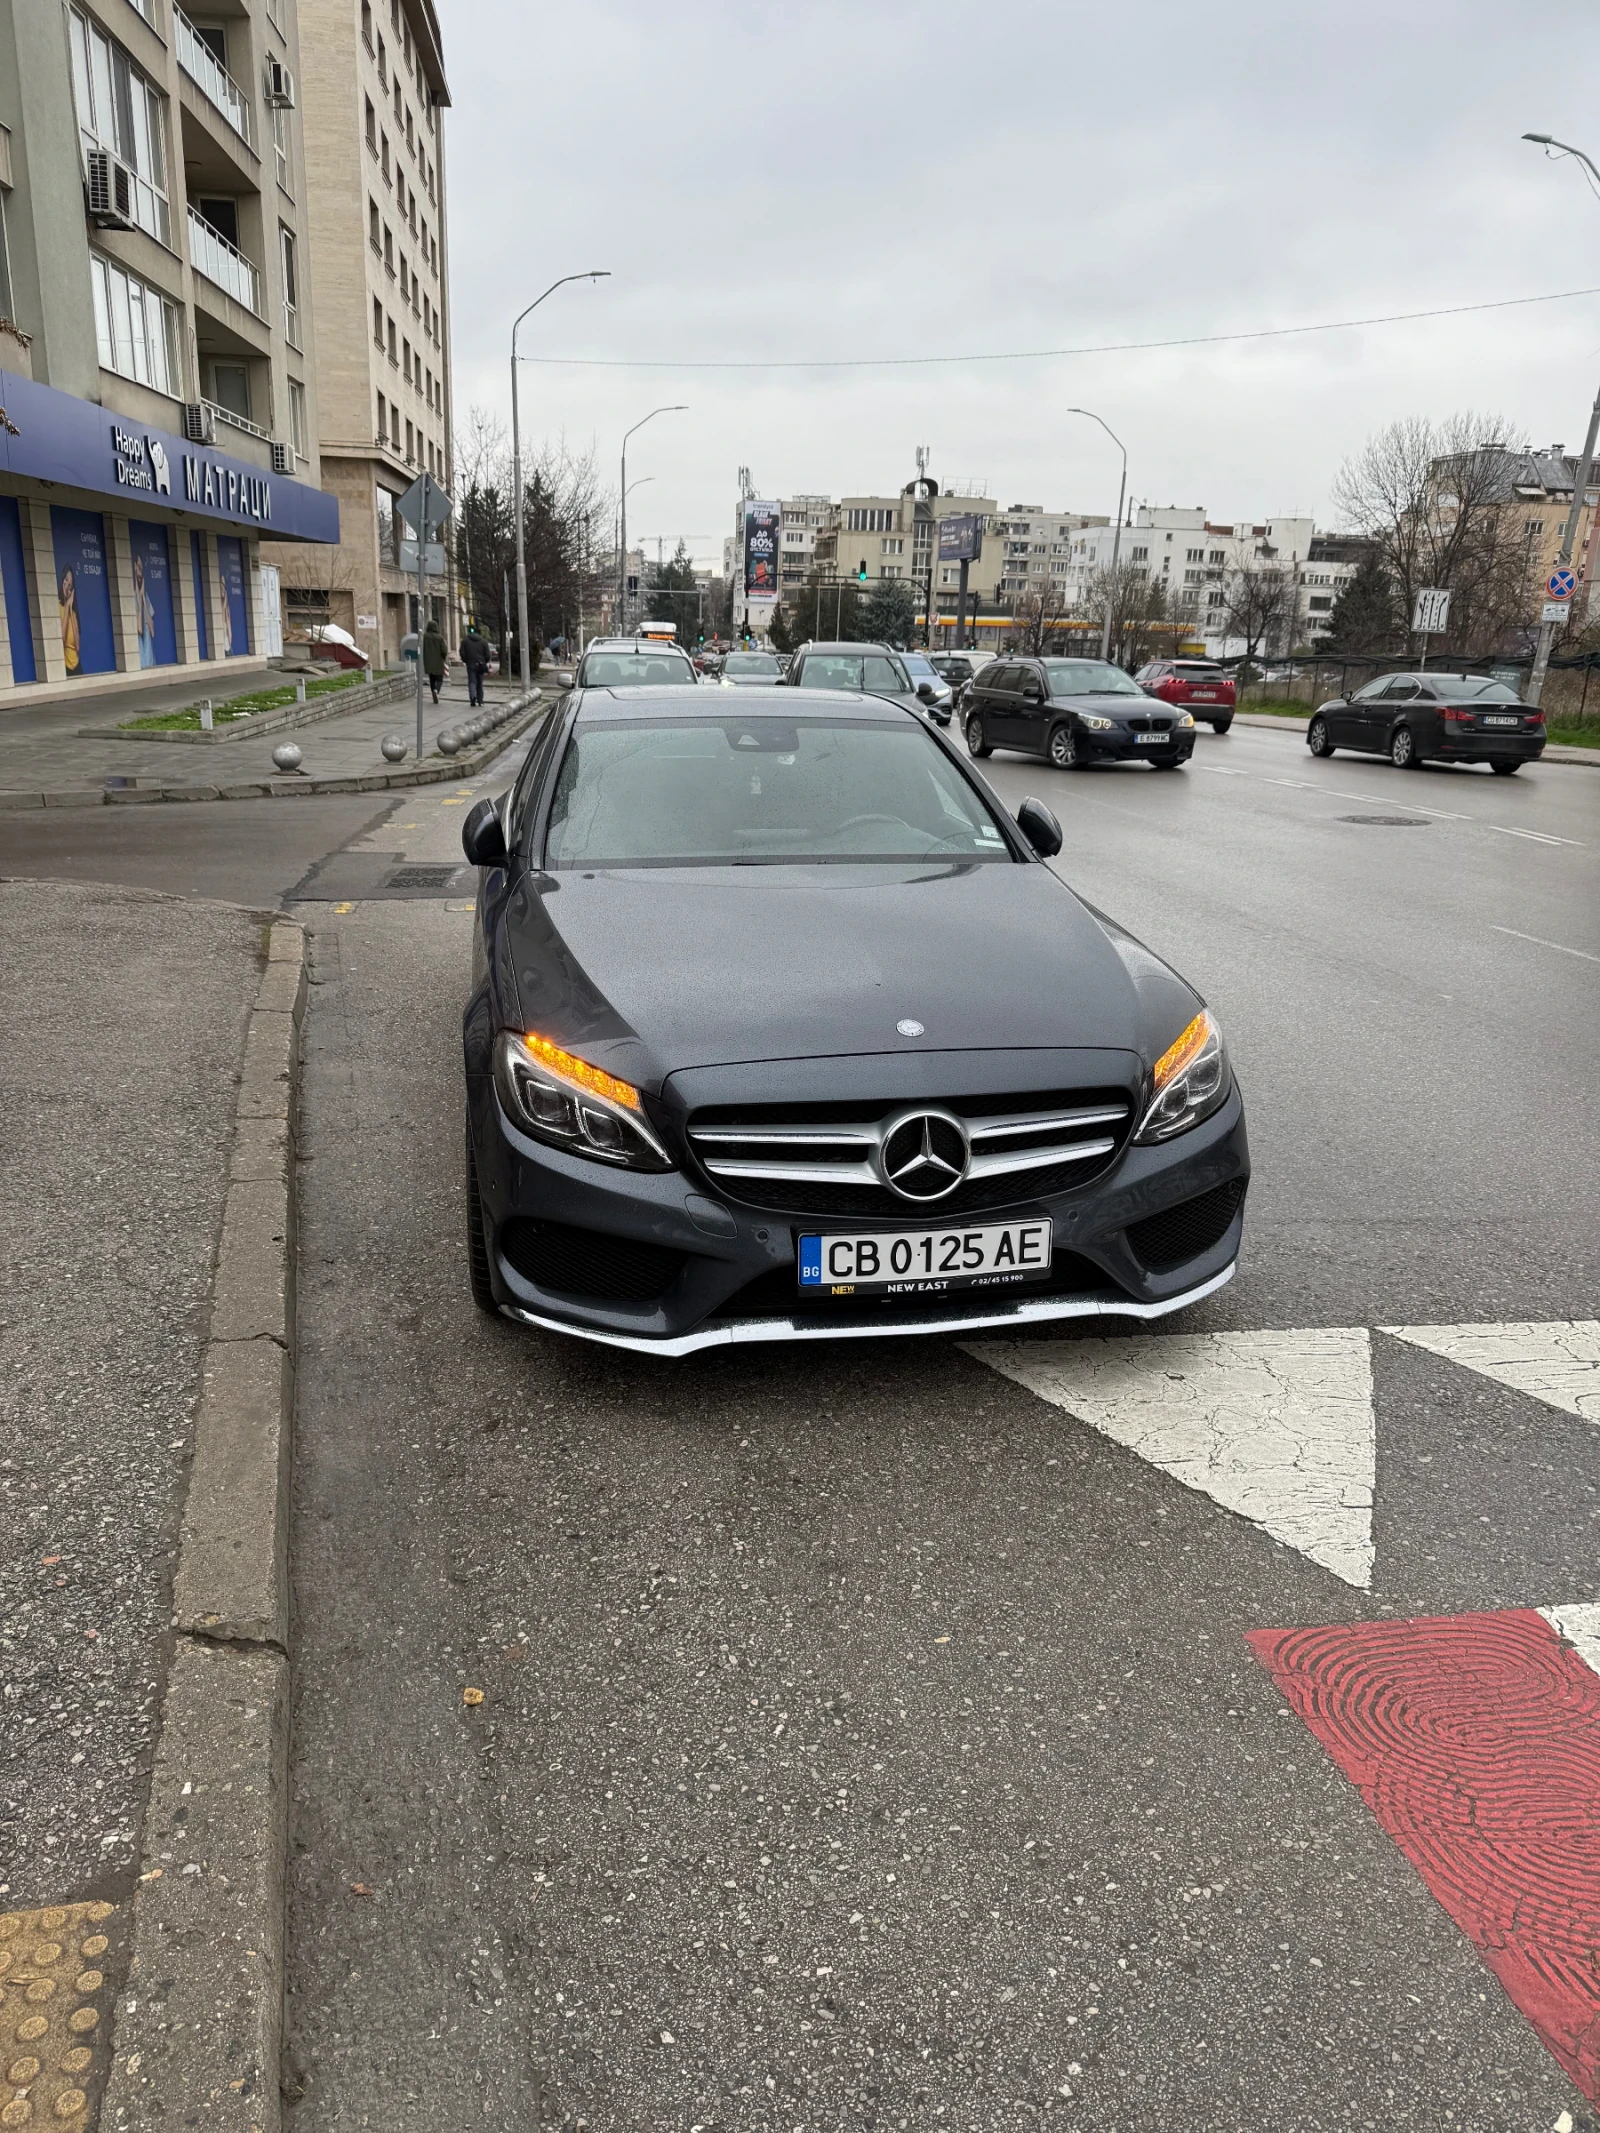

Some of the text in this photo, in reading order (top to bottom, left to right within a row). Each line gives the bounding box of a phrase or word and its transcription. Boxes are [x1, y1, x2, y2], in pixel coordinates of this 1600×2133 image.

[114, 425, 145, 465] Happy
[117, 458, 152, 491] Dreams
[185, 454, 272, 521] МАТРАЦИ
[750, 537, 774, 548] 80%
[828, 1227, 1042, 1277] CB 0125 AE
[802, 1266, 820, 1278] BG
[1010, 1274, 1024, 1282] 900
[830, 1284, 855, 1295] NEW
[887, 1281, 949, 1294] NEW EAST
